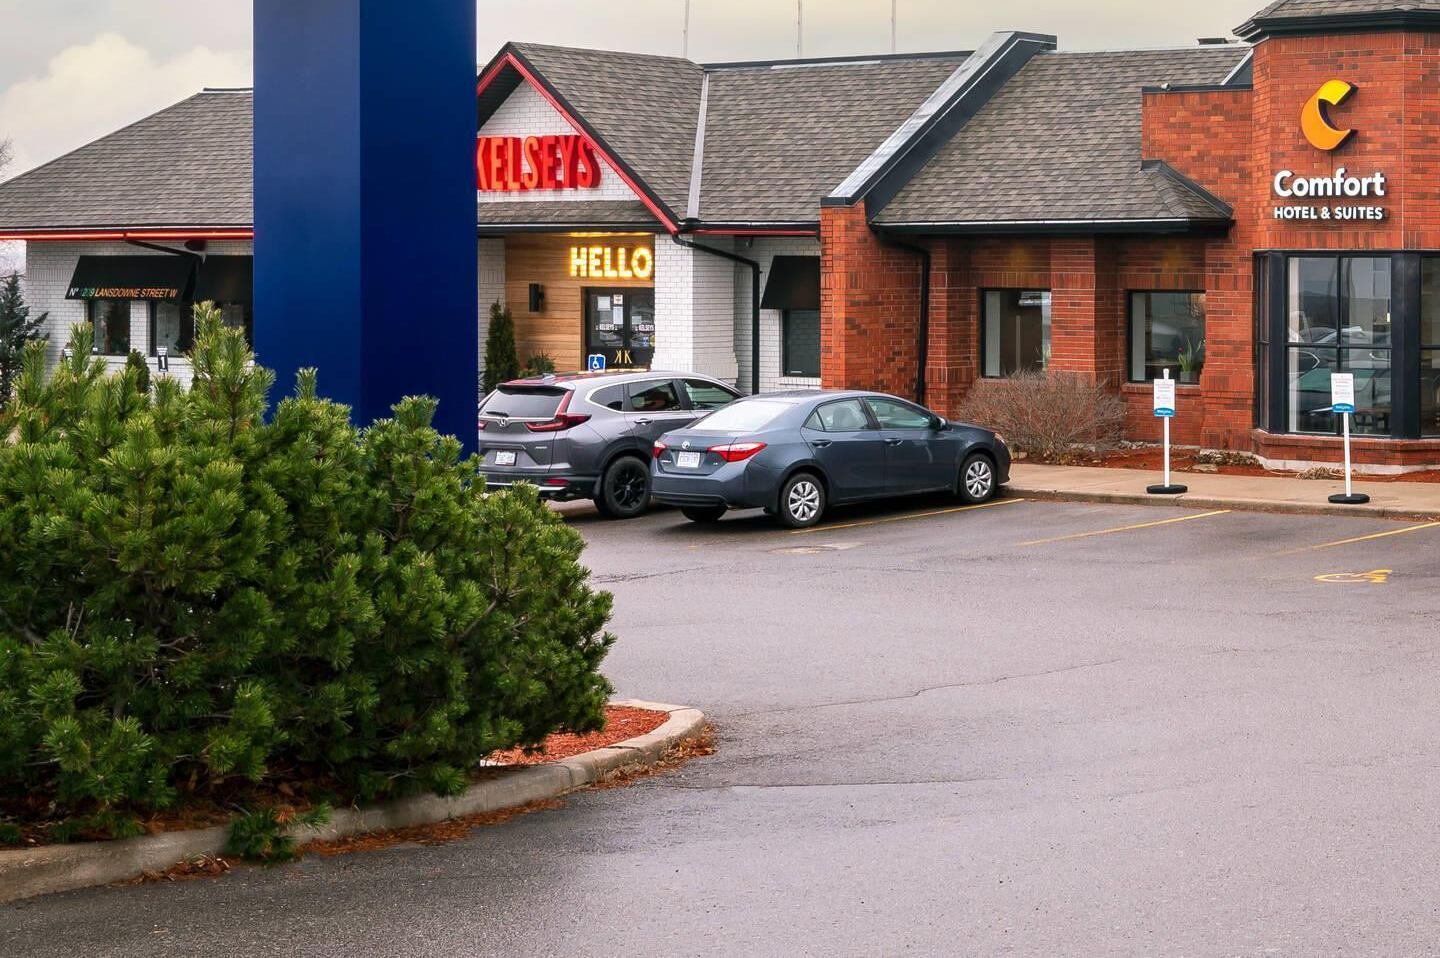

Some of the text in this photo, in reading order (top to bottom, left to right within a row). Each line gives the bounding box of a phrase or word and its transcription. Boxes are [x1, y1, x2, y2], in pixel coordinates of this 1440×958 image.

[477, 135, 598, 190] KELSEYS
[1273, 168, 1386, 197] Comfort
[1274, 206, 1384, 219] HOTEL & SUITES
[569, 246, 653, 278] HELLO
[95, 287, 140, 298] LANSDOWNE
[140, 287, 168, 298] STREET
[168, 288, 178, 298] W
